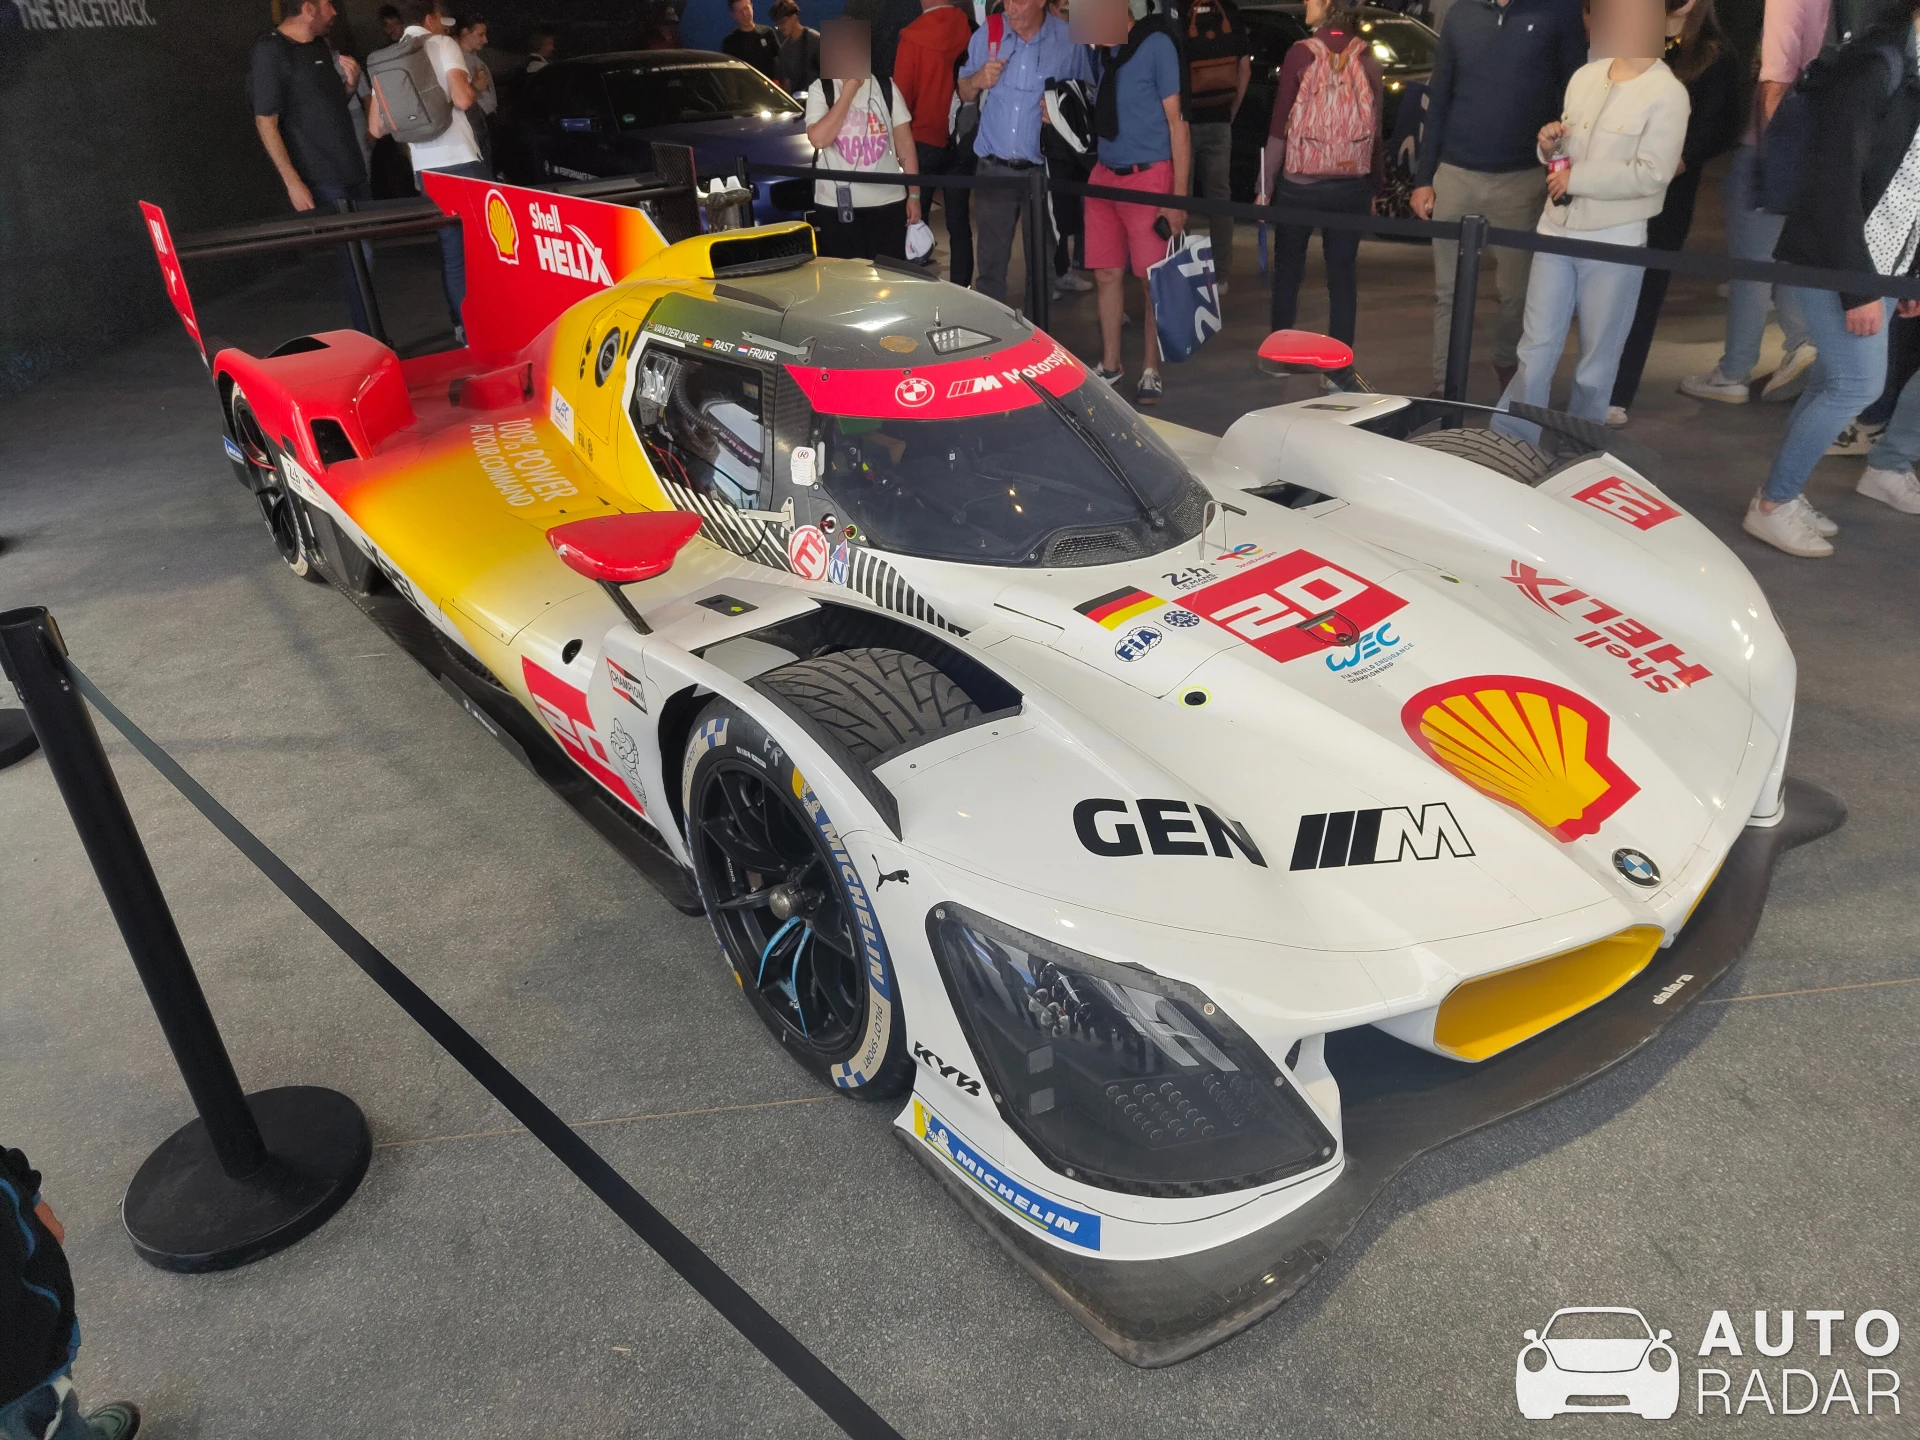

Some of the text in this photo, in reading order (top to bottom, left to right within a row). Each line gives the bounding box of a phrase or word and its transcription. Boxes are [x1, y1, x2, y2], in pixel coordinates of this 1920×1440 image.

[12, 0, 58, 29] THE
[834, 135, 888, 166] MANS
[529, 202, 562, 233] Shell
[533, 224, 615, 287] HELIX
[653, 323, 701, 344] VAN DER LINDE
[712, 339, 735, 353] RAST
[1001, 344, 1068, 385] Motorsport
[470, 424, 535, 507] AT YOUR COMMAND
[497, 417, 579, 502] 100% POWER
[1585, 482, 1662, 523] HY
[832, 560, 845, 583] N
[1161, 567, 1211, 586] 24h
[1209, 565, 1370, 640] 20
[1500, 558, 1714, 689] HELIX
[1326, 622, 1400, 672] WEC
[1340, 642, 1415, 680] FIA WORLD ENDURANCE
[1573, 630, 1681, 693] Shell
[610, 669, 645, 704] CHAMPION
[1347, 661, 1395, 684] CHAMPIONSHIP
[1072, 798, 1269, 869] GEN
[726, 855, 737, 883] ACING
[819, 822, 885, 986] MICHELIN
[1652, 974, 1695, 1005] dallara
[862, 1000, 883, 1070] PILOT SPORT
[913, 1040, 982, 1097] KYB
[956, 1149, 1080, 1234] MICHELIN
